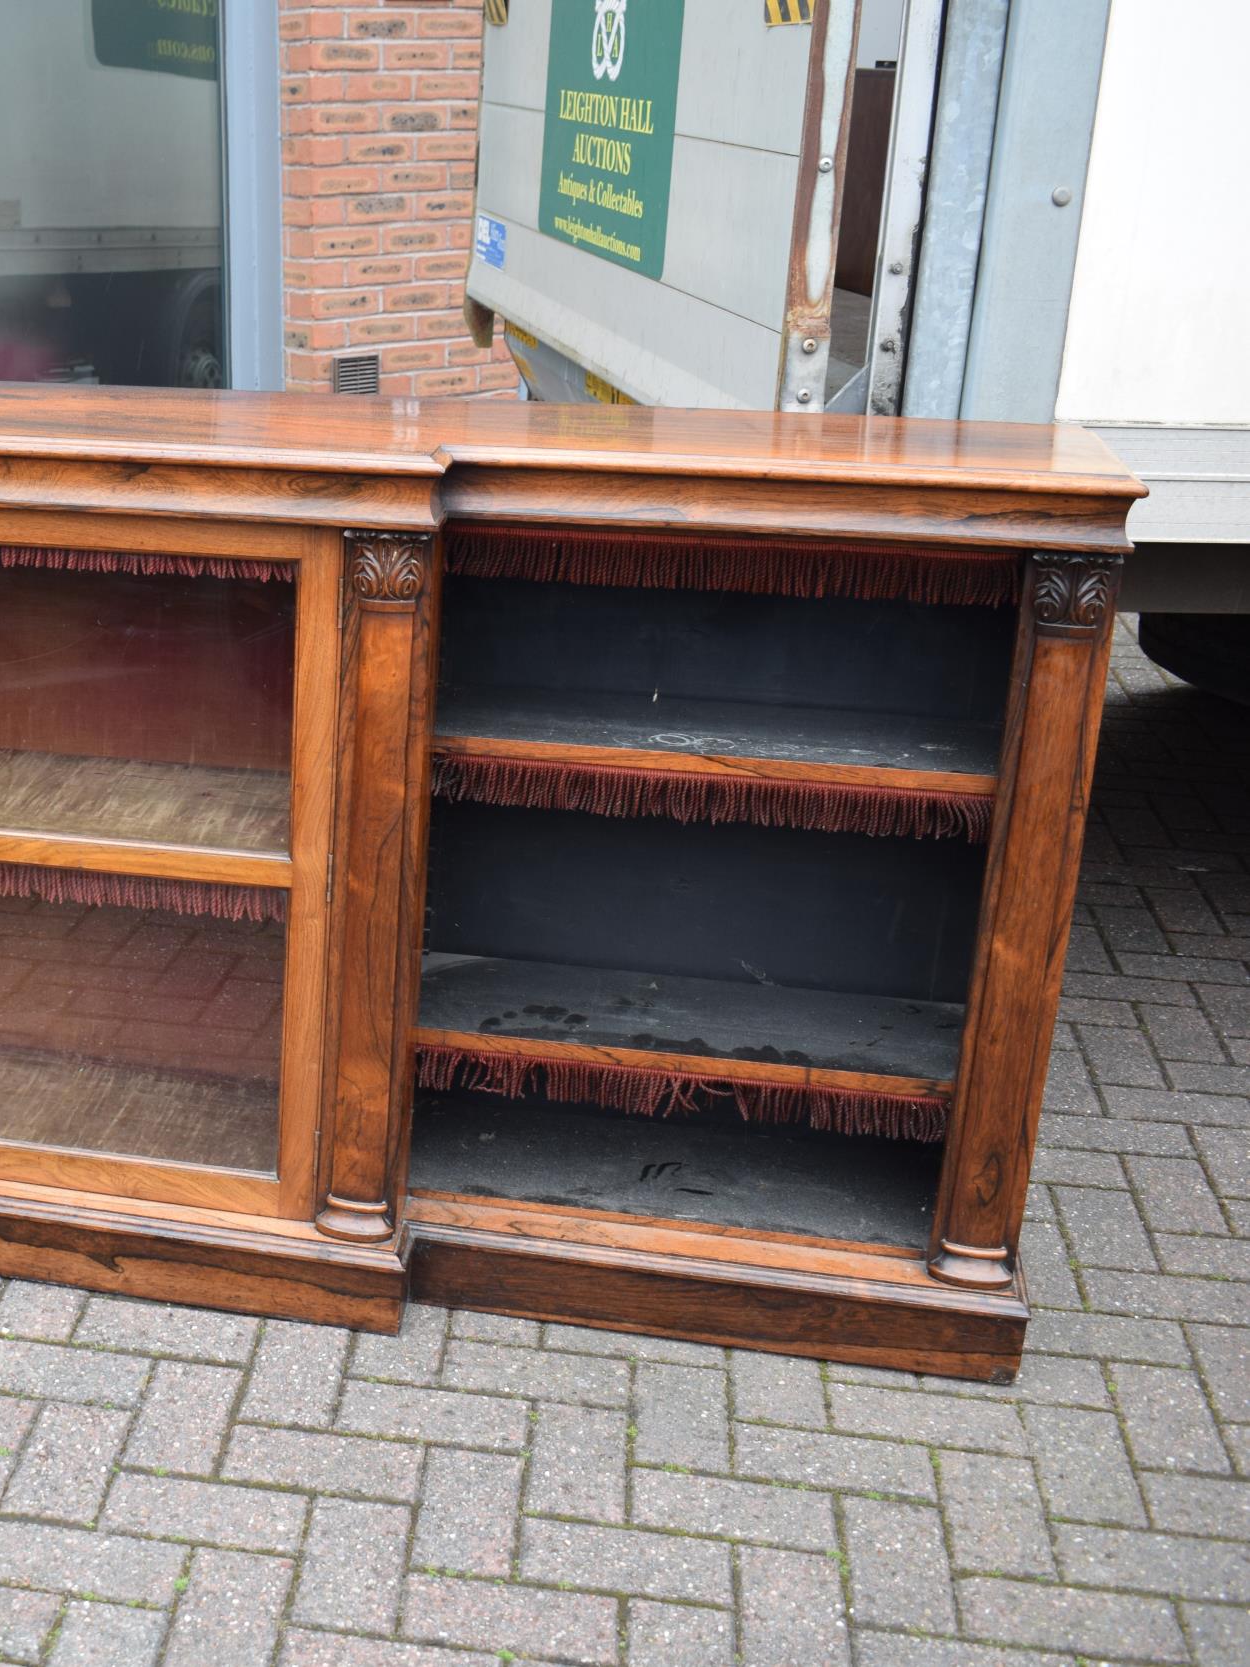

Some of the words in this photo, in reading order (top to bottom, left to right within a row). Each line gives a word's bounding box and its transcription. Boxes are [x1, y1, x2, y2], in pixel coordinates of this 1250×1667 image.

[559, 89, 618, 128] LEIGHTON
[619, 96, 654, 134] HALL
[573, 132, 631, 176] AUCTIONS
[558, 171, 588, 206] Antiques
[588, 178, 596, 204] &
[596, 180, 644, 219] Collectables
[554, 215, 641, 262] www.leightonhallauctions.com
